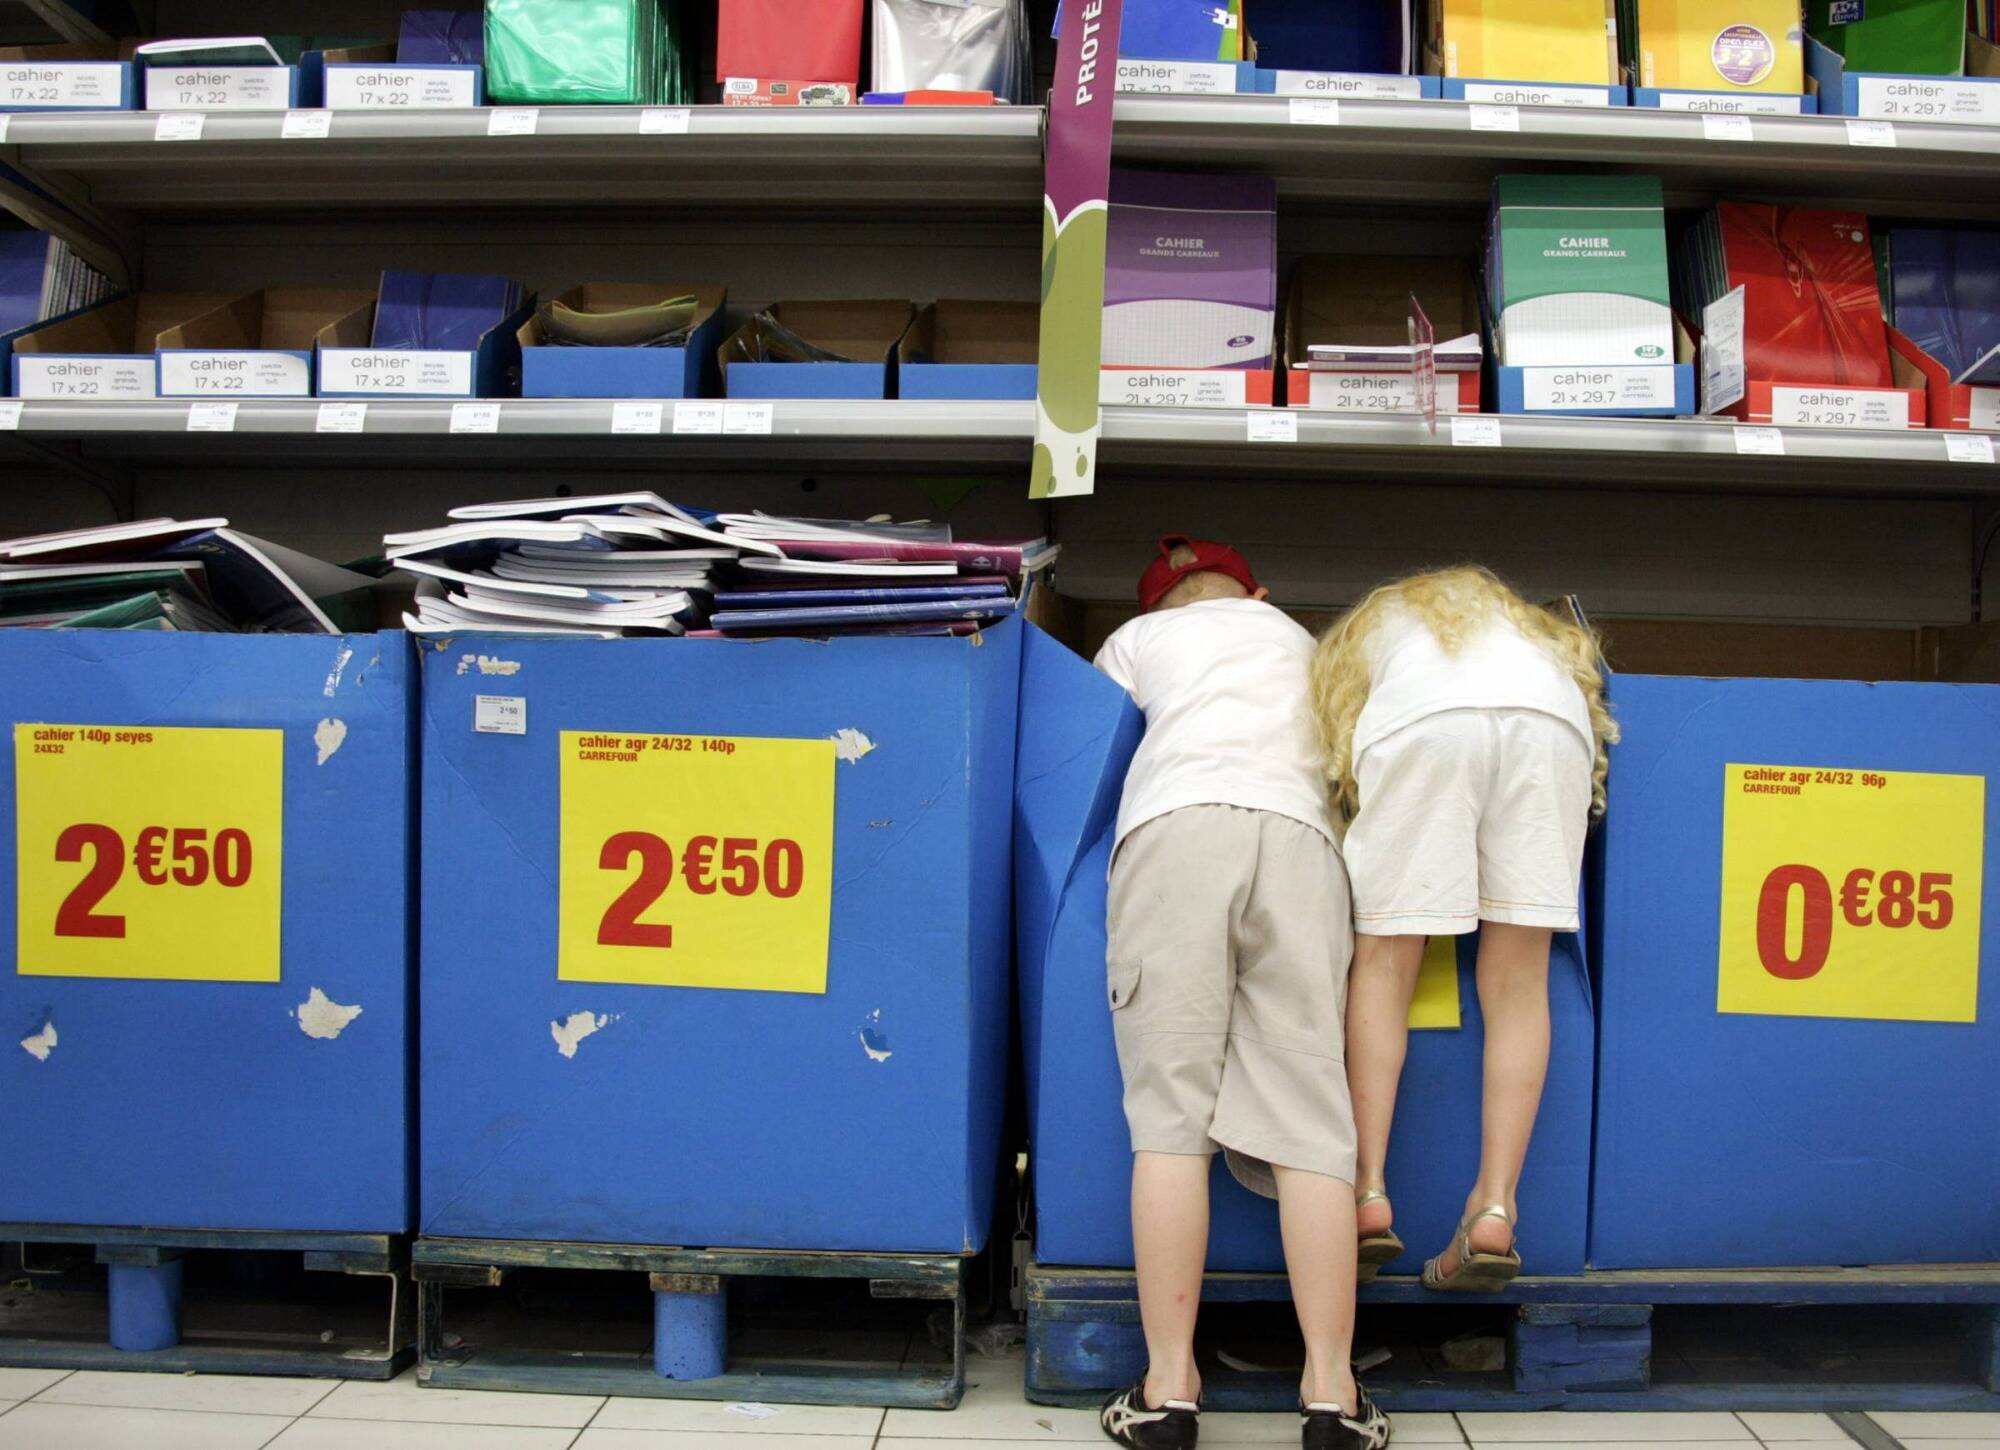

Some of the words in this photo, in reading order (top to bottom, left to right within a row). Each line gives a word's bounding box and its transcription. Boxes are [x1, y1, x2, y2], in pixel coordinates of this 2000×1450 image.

[1076, 0, 1102, 106] PROTÈ
[7, 68, 64, 82] cahier
[1118, 64, 1176, 78] cahier
[175, 72, 232, 86] cahier
[356, 73, 414, 86] cahier
[1305, 78, 1362, 91] cahier
[12, 88, 24, 100] 17
[27, 91, 34, 100] x
[39, 88, 58, 100] 22
[1887, 83, 1944, 97] cahier
[180, 92, 192, 104] 17
[196, 96, 204, 104] x
[208, 92, 226, 104] 22
[360, 92, 373, 104] 17
[389, 92, 408, 105] 22
[1494, 90, 1552, 104] cahier
[1688, 98, 1744, 112] cahier
[1884, 101, 1898, 113] 21
[1902, 106, 1910, 114] x
[1914, 102, 1946, 116] 29.7
[1156, 236, 1204, 249] CAHIER
[1559, 237, 1609, 248] CAHIER
[1139, 248, 1174, 257] GRANDS
[1176, 249, 1220, 258] CARREAUX
[1543, 250, 1580, 258] GRANDS
[1581, 250, 1626, 258] CARREAUX
[190, 358, 248, 370] cahier
[351, 354, 410, 368] cahier
[48, 362, 103, 376] cahier
[194, 376, 208, 388] 17
[224, 376, 243, 389] 22
[355, 374, 368, 386] 17
[385, 374, 406, 387] 22
[1128, 374, 1186, 388] cahier
[1340, 376, 1400, 390] cahier
[1553, 372, 1613, 385] cahier
[52, 382, 64, 394] 17
[68, 386, 76, 394] x
[80, 382, 98, 394] 22
[1126, 394, 1140, 405] 21
[1156, 394, 1188, 406] 29.7
[1336, 396, 1351, 408] 21
[1355, 399, 1364, 407] x
[1368, 396, 1401, 410] 29.7
[1551, 392, 1565, 404] 21
[1582, 391, 1616, 404] 29.7
[1800, 393, 1854, 406] cahier
[1797, 412, 1810, 423] 21
[1814, 416, 1821, 424] x
[1826, 412, 1856, 425] 29.7
[34, 728, 75, 741] cahier
[78, 729, 111, 744] 140p
[114, 732, 153, 745] seyes
[34, 744, 64, 754] 24X32
[578, 735, 622, 749] cahier
[625, 738, 648, 752] agr
[652, 736, 692, 751] 24/32
[701, 739, 736, 755] 140p
[578, 750, 638, 762] CARREFOUR
[1744, 768, 1786, 782] cahier
[1789, 772, 1812, 785] agr
[1815, 771, 1854, 785] 24/32
[1862, 774, 1886, 788] 96p
[1743, 783, 1801, 795] CARREFOUR
[54, 823, 252, 939] 2€50
[597, 830, 804, 949] 2€50
[1756, 863, 1954, 980] 0€85
